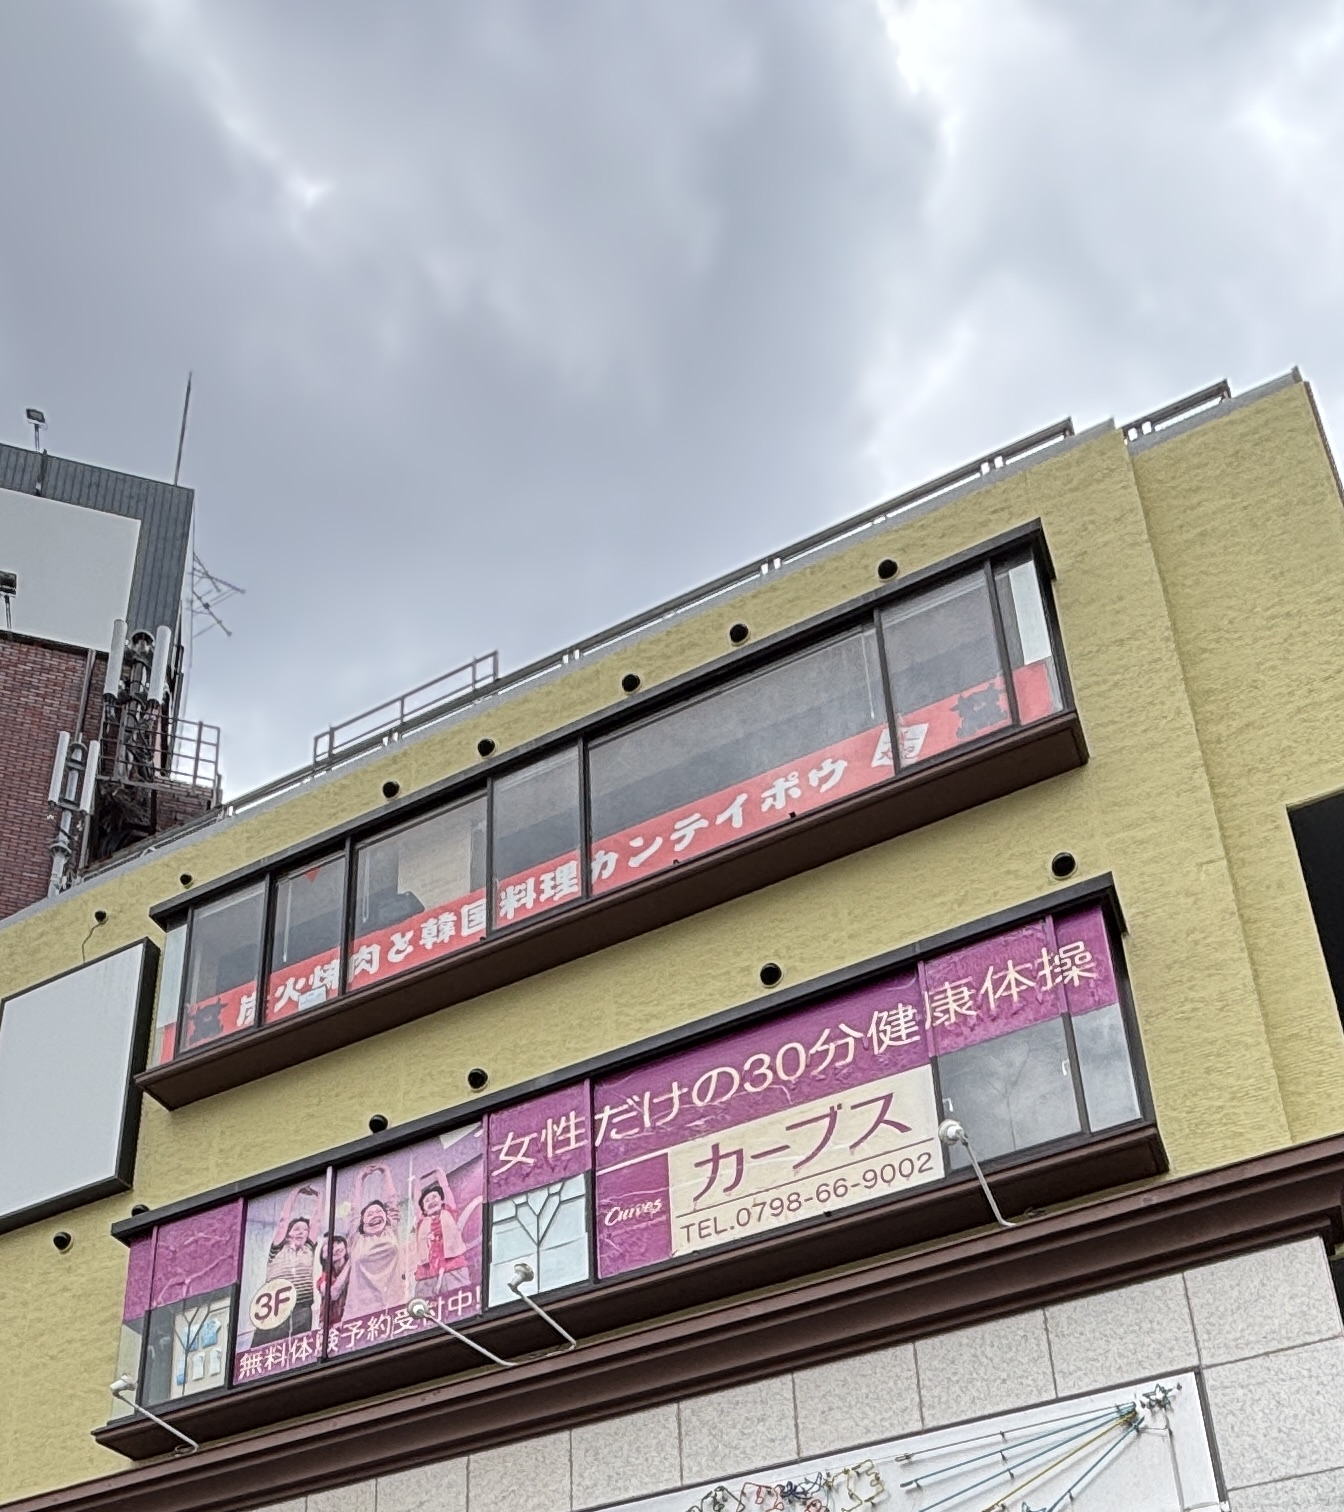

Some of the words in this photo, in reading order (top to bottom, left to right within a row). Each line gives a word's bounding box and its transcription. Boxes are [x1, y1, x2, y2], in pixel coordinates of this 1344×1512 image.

[491, 940, 1096, 1176] 女性だけの30分健康体操
[692, 1091, 912, 1203] カーブス
[604, 1196, 663, 1228] Curves
[681, 1151, 934, 1246] TEL.0798-66-9002
[253, 1290, 296, 1322] 3F
